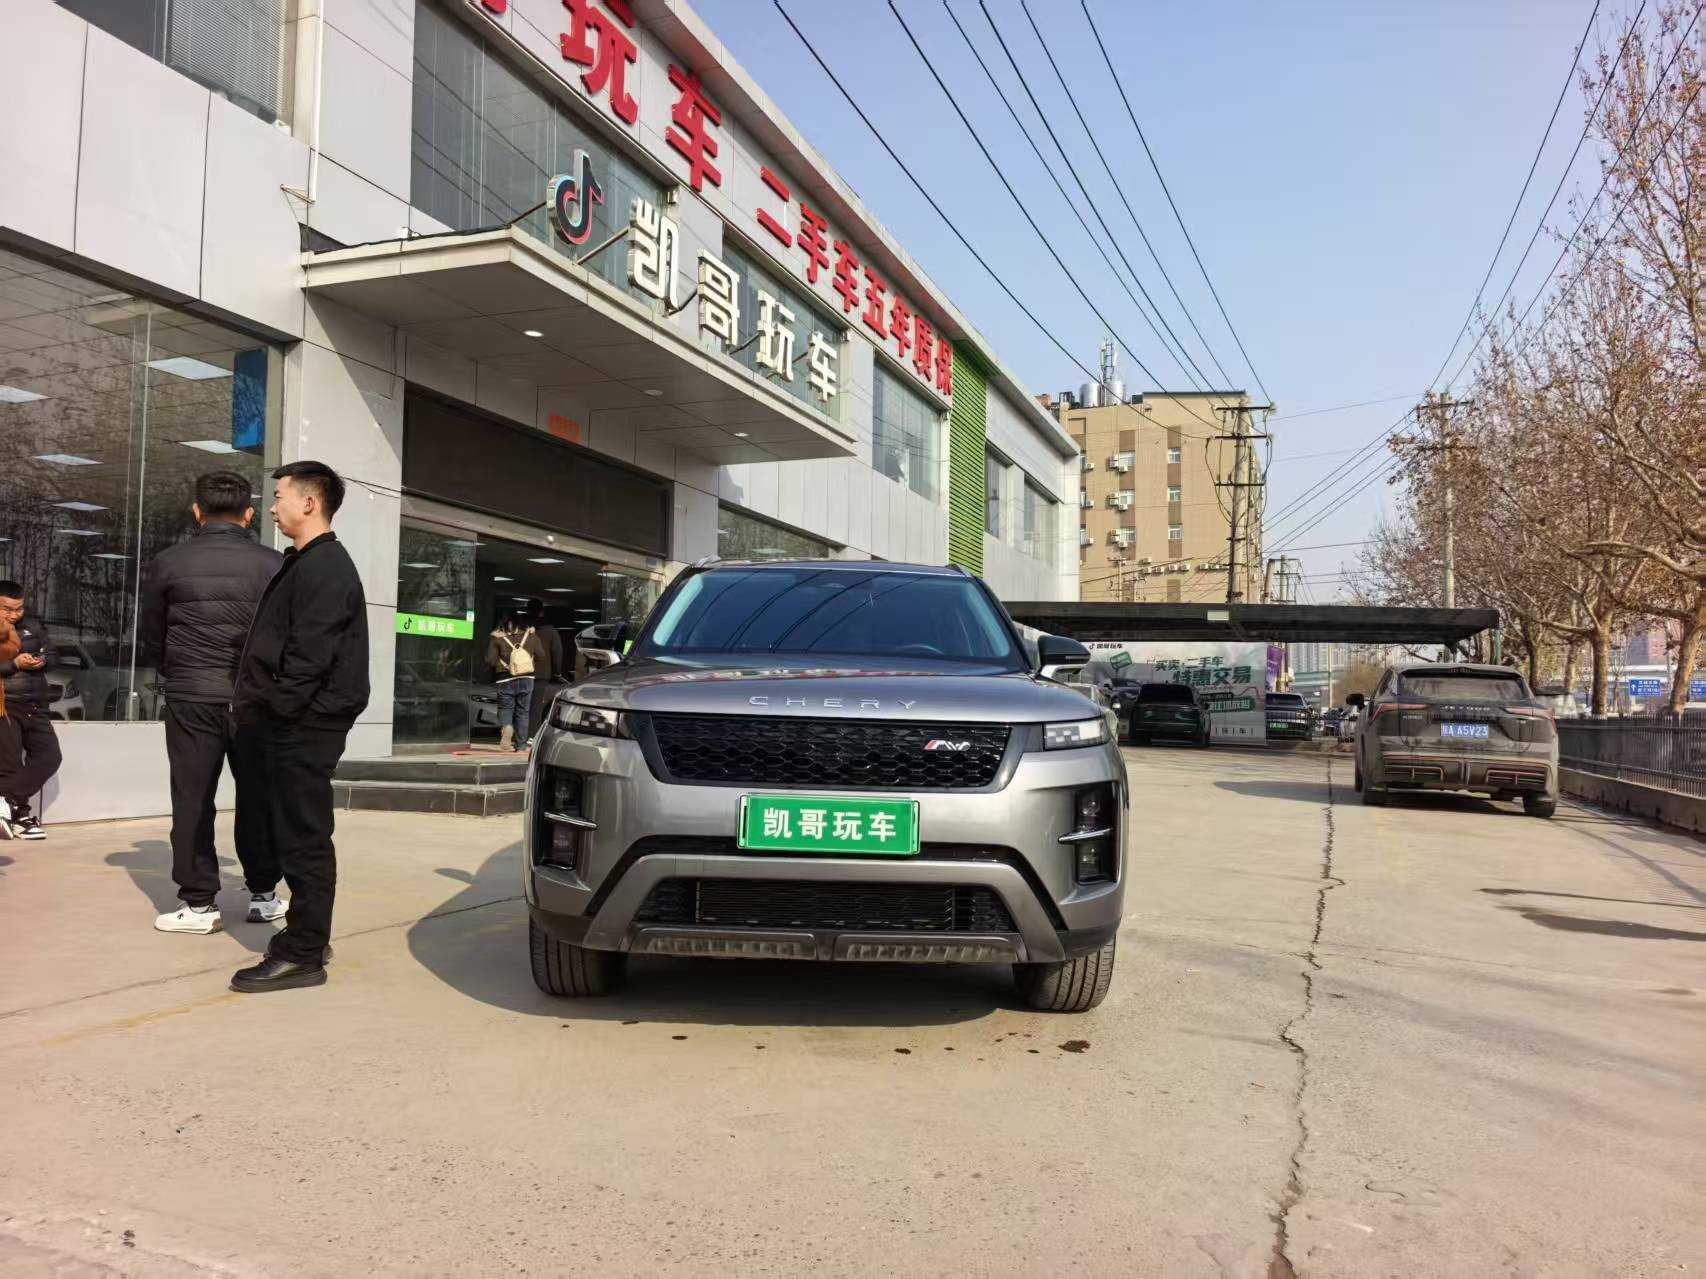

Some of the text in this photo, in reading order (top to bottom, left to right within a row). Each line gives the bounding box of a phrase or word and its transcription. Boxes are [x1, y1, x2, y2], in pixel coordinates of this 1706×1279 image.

[481, 0, 722, 192] 玩车
[628, 197, 838, 403] 凯哥玩车
[749, 695, 917, 710] CHERY
[763, 806, 897, 843] 凯哥玩车
